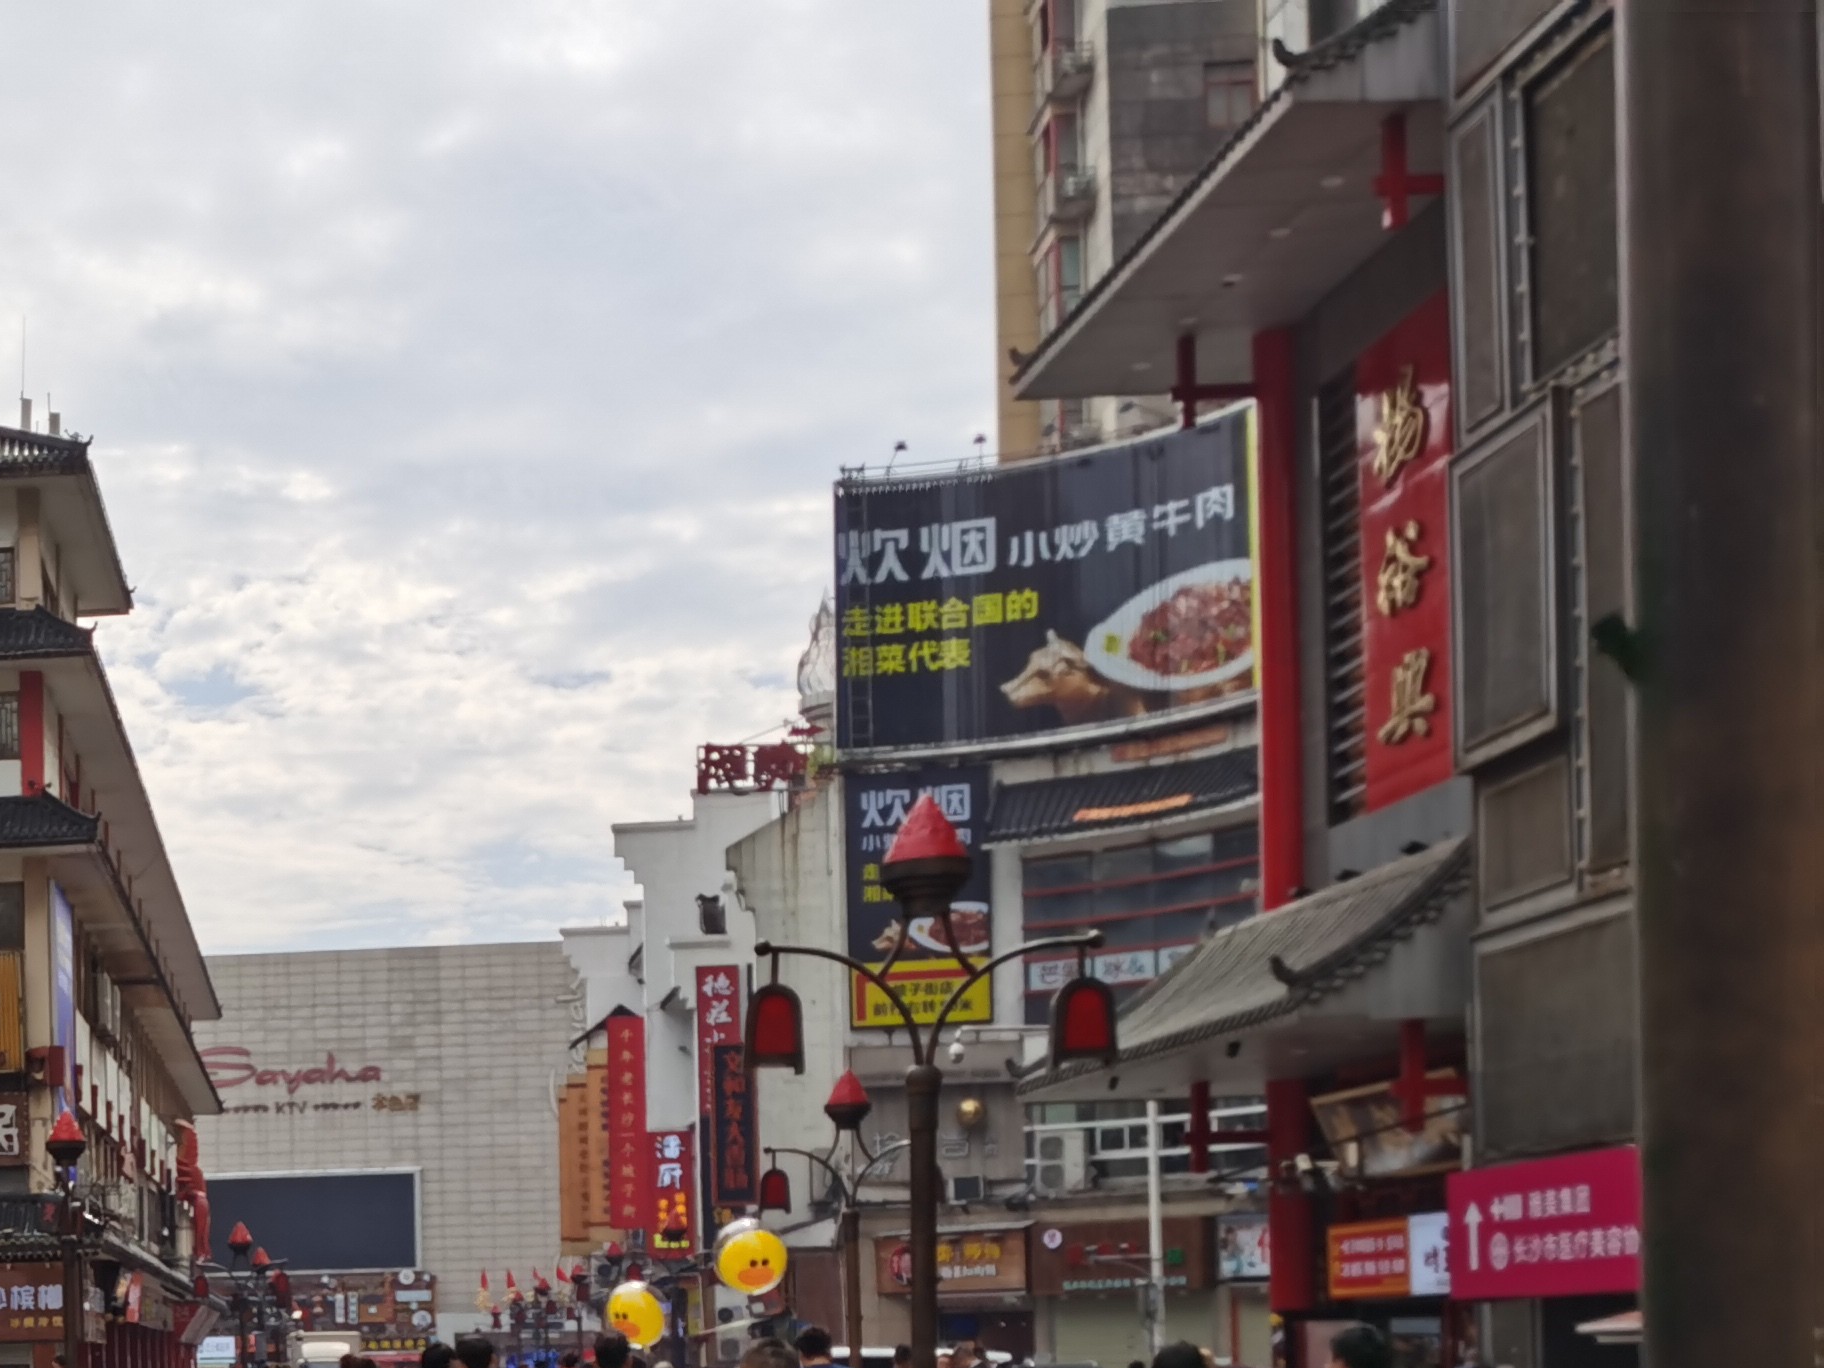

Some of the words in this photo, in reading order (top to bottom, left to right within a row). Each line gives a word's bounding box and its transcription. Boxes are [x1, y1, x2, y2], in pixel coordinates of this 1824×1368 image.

[838, 517, 997, 585] 炊烟
[1009, 484, 1234, 568] 小炒黄牛肉
[842, 588, 1040, 636] 走进联合国的
[842, 637, 971, 677] 湘菜代表
